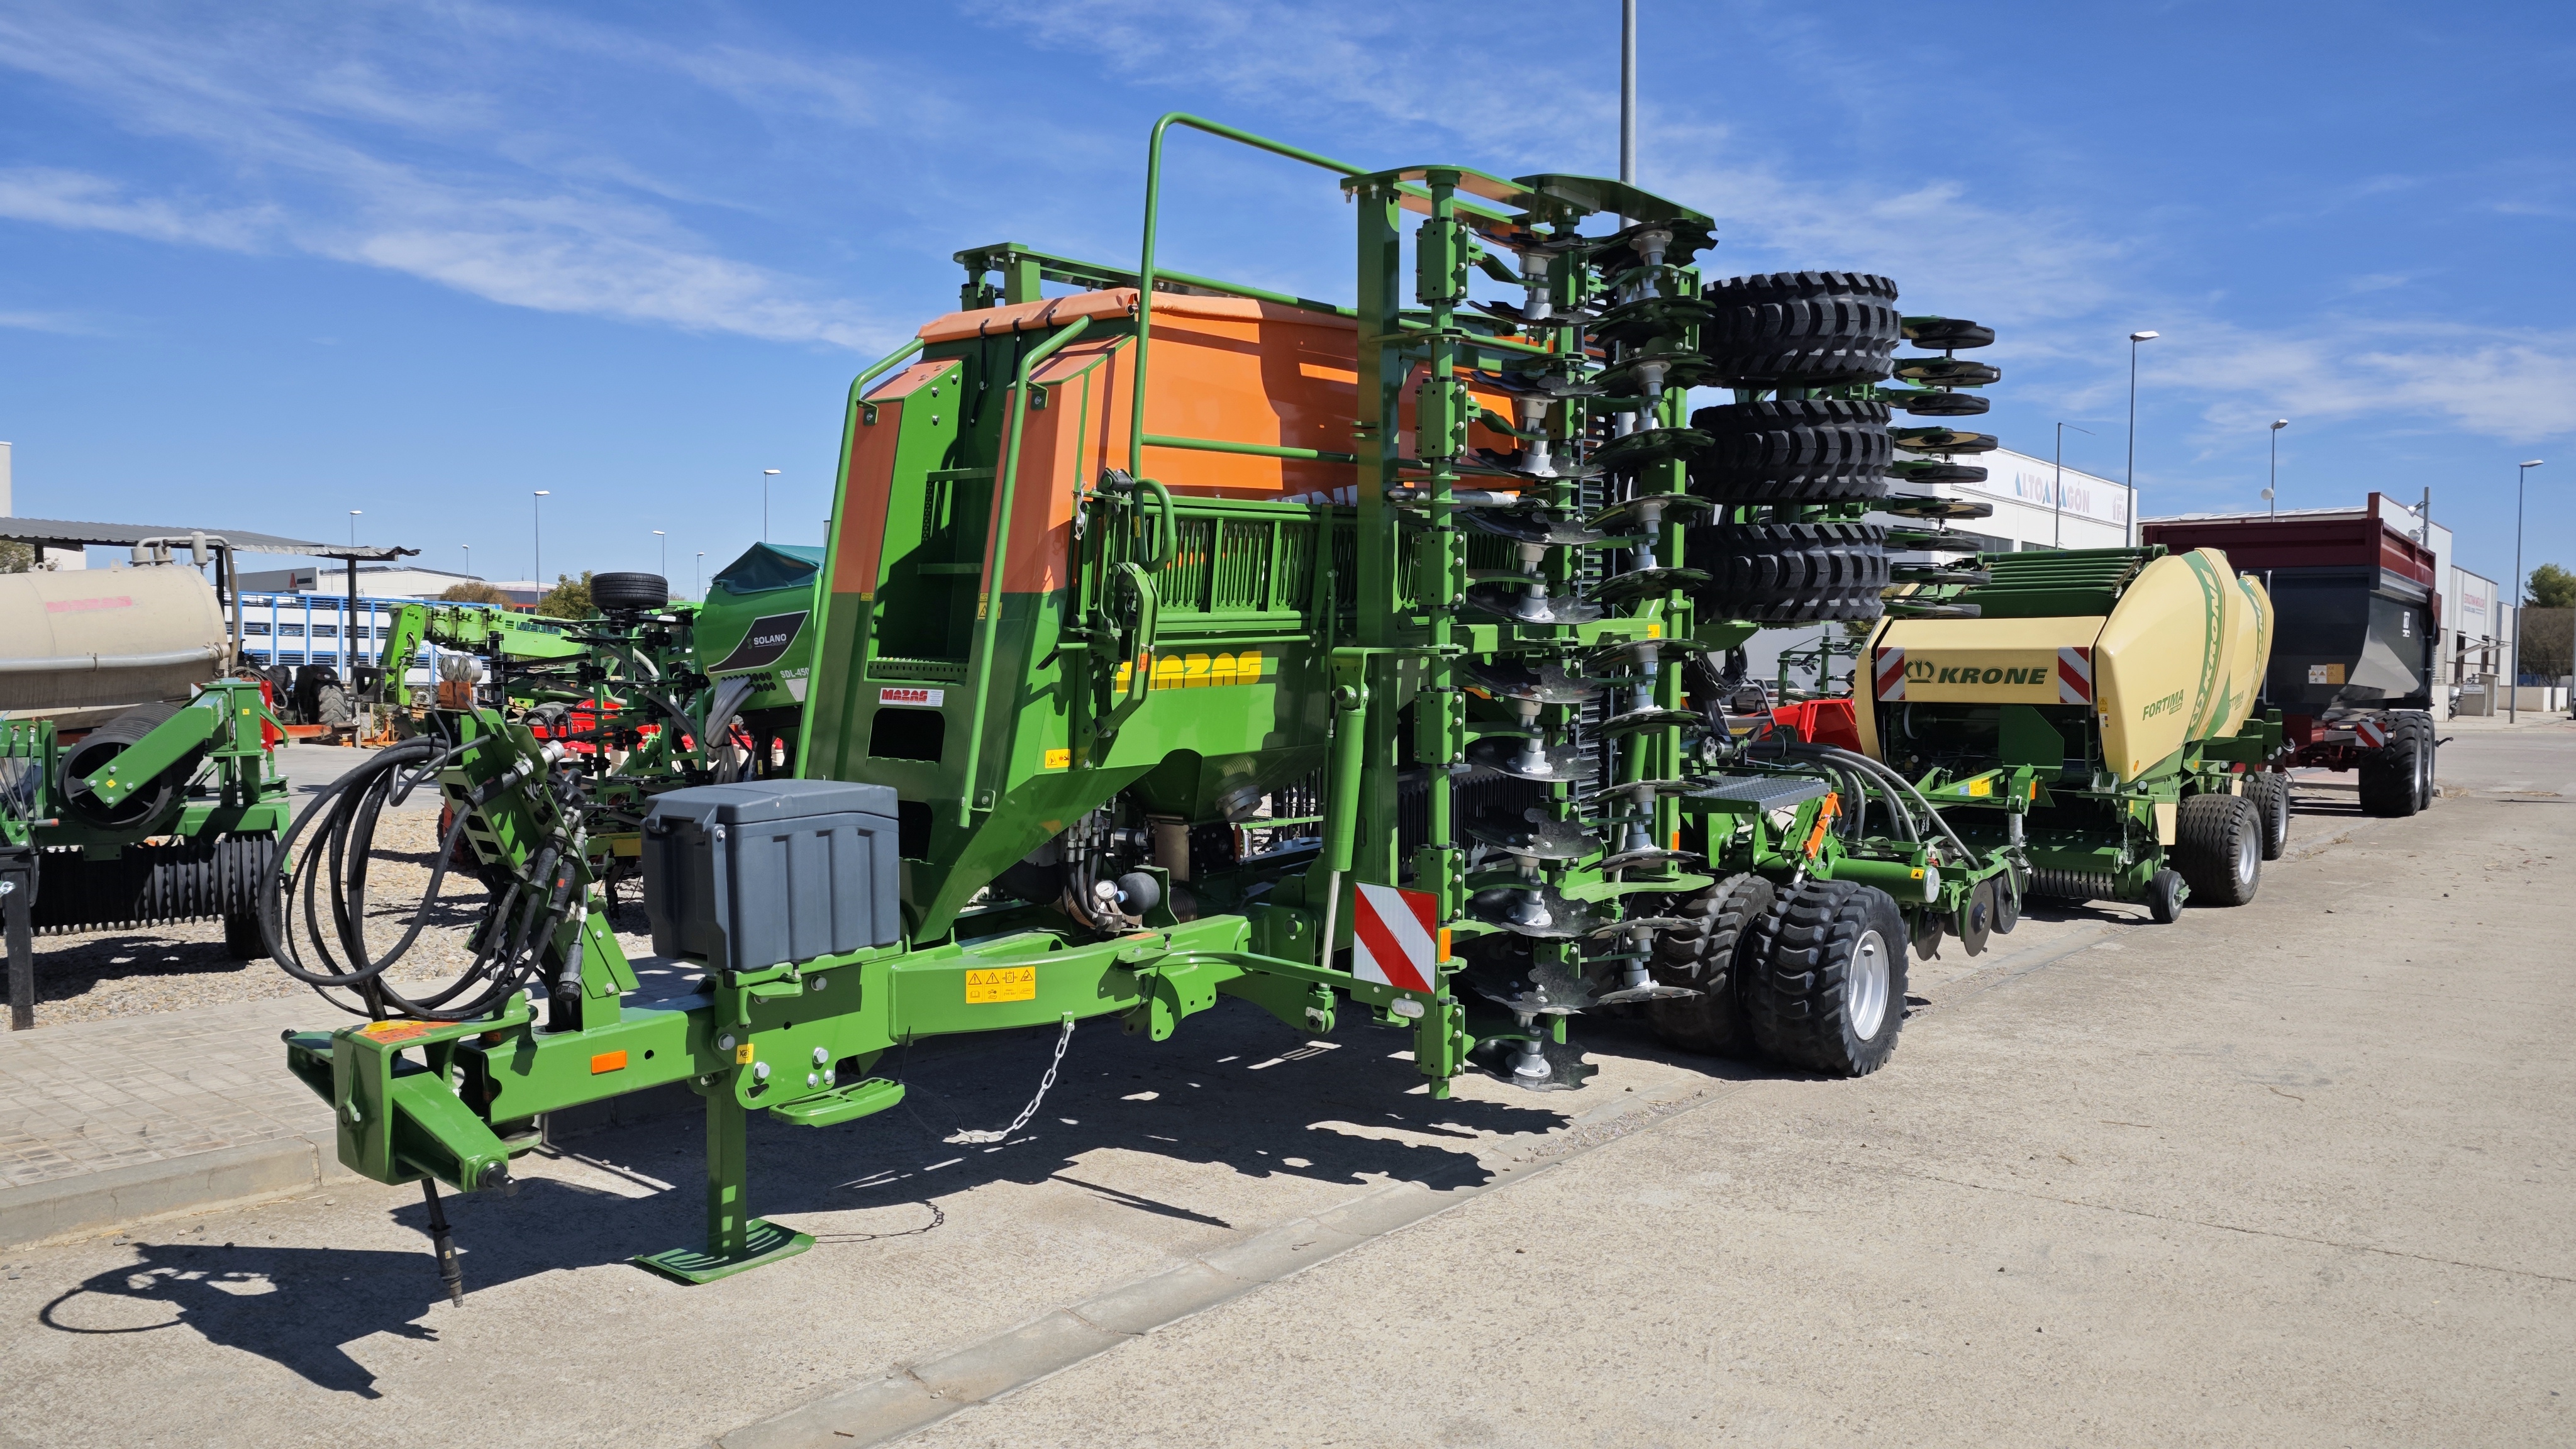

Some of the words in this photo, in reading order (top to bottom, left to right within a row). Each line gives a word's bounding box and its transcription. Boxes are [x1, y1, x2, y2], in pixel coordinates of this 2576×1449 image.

[2200, 568, 2219, 691] KRONE
[754, 633, 787, 645] SOLANO
[1938, 668, 2048, 684] KRONE
[882, 689, 928, 701] MAZAS
[2142, 689, 2184, 721] FORTIMA
